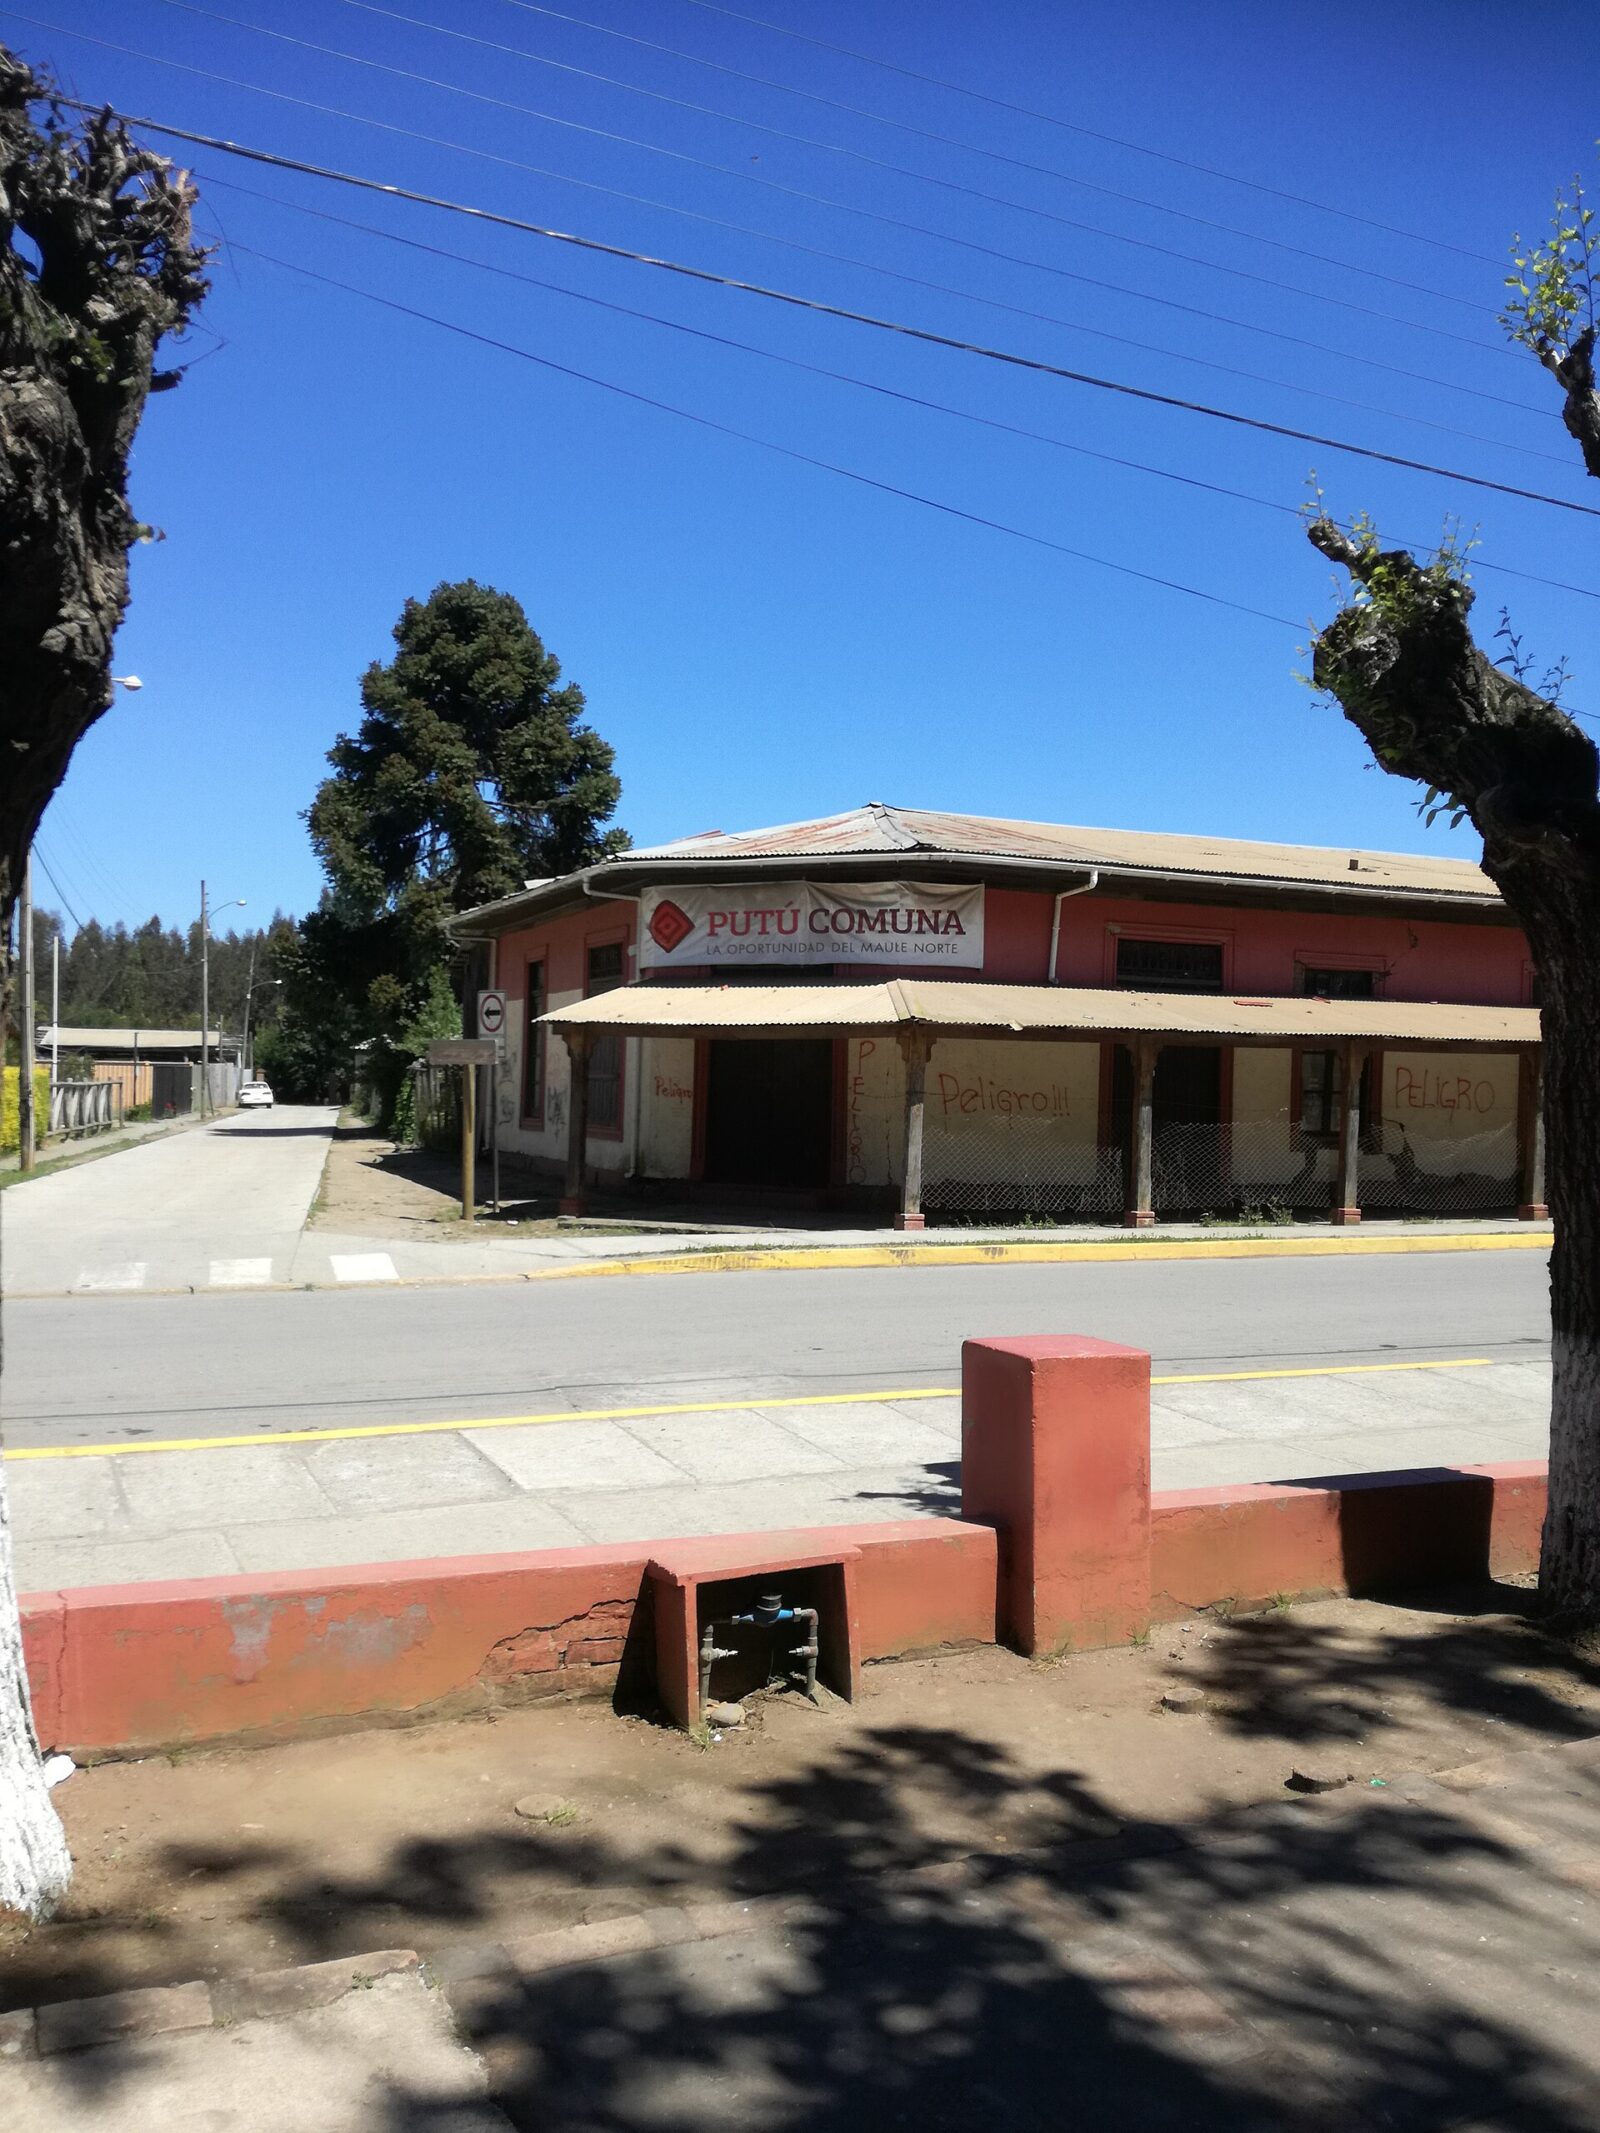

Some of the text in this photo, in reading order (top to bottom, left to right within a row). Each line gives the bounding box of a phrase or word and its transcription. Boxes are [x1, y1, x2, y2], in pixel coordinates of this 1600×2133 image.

[707, 901, 966, 937] PUTÚ COMUNA
[706, 942, 958, 955] LA OPORTUNIDAD DEL MAULE NORTE
